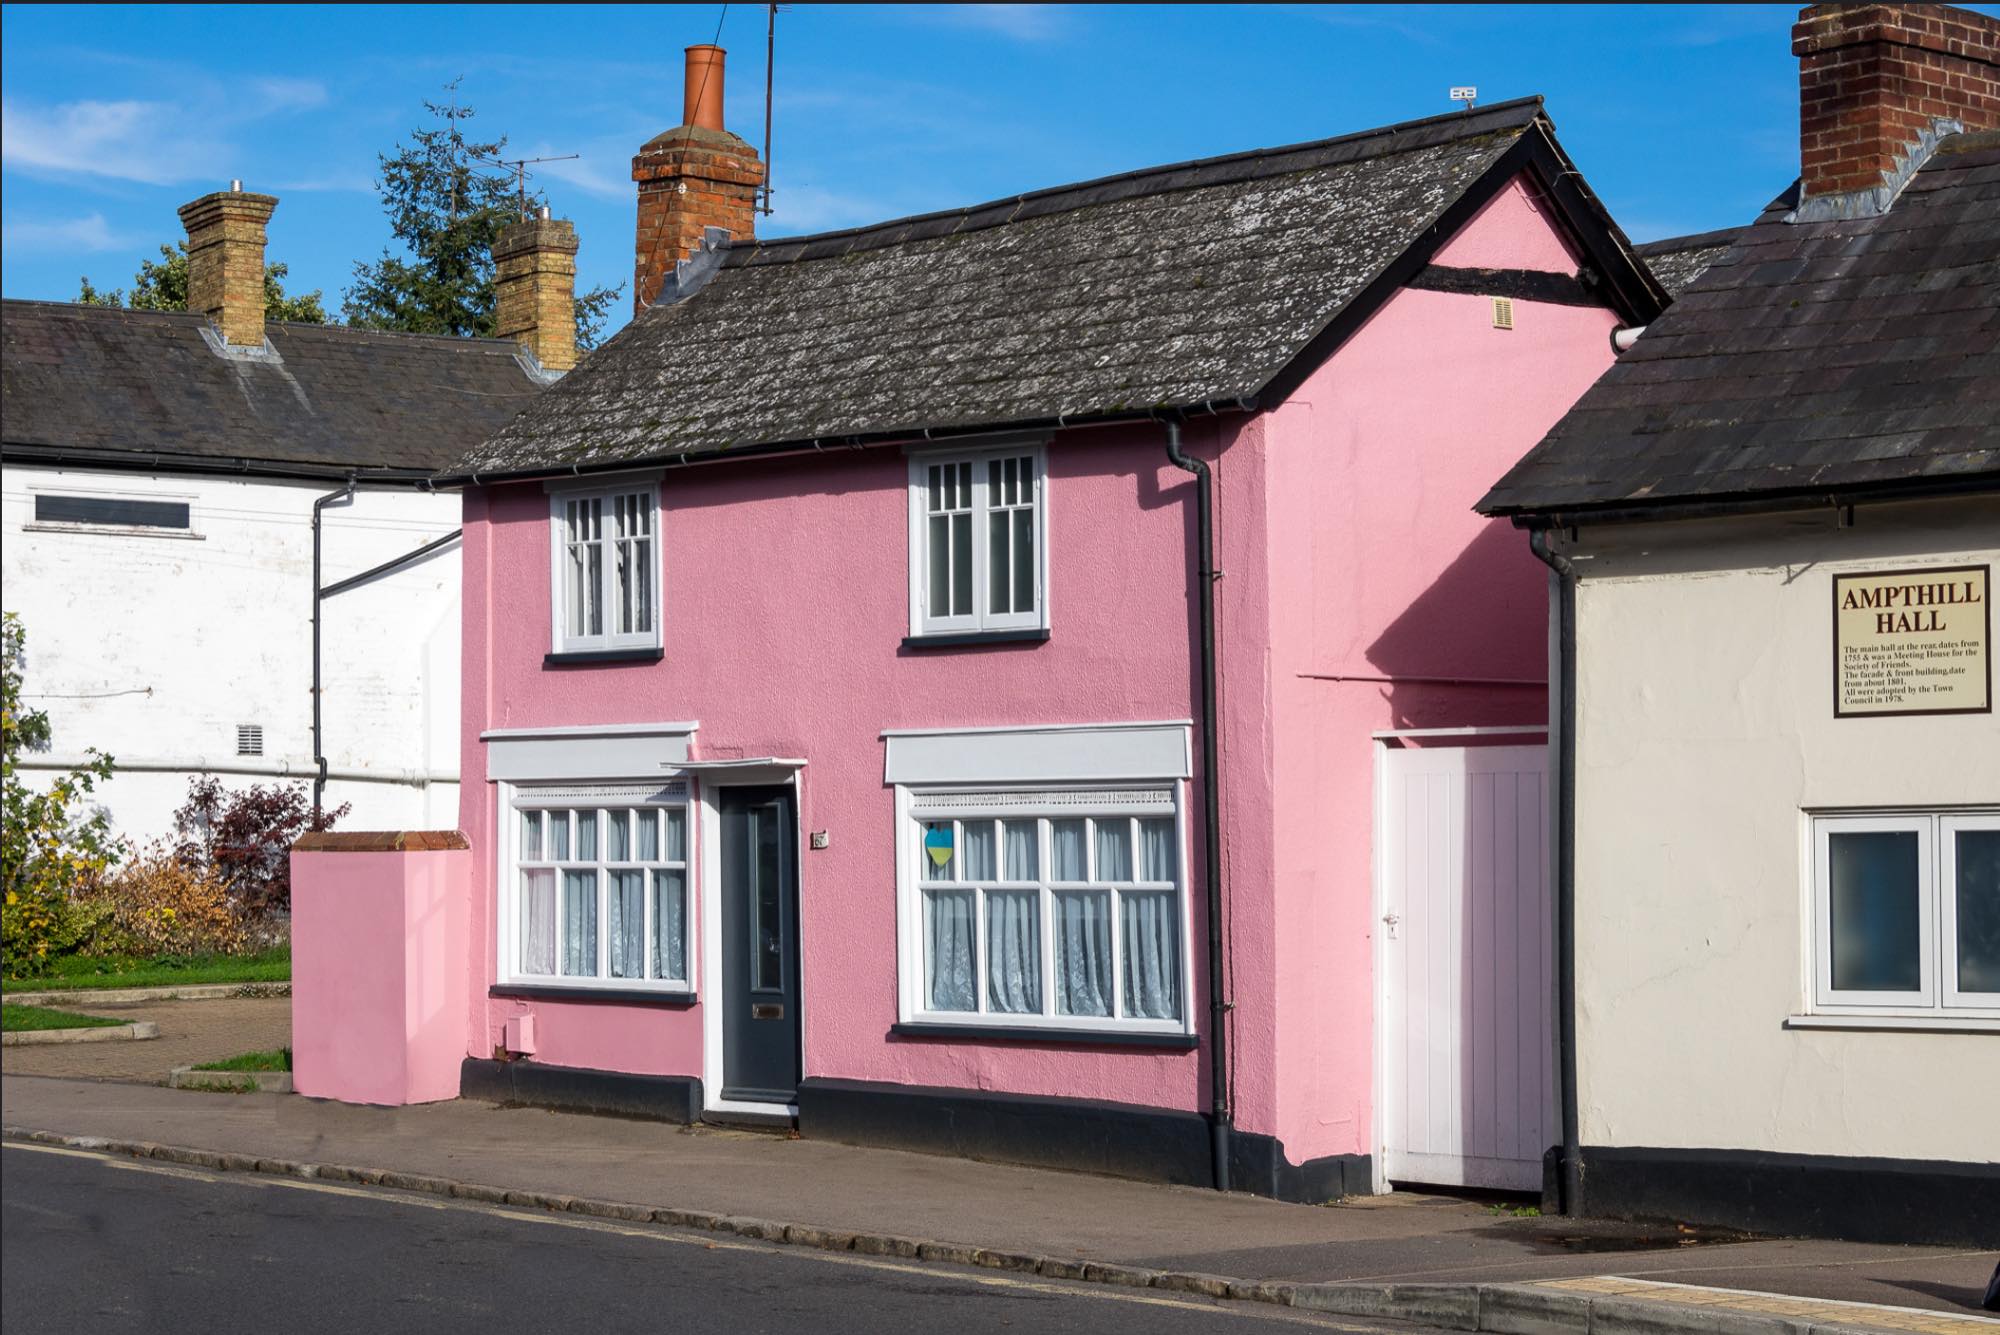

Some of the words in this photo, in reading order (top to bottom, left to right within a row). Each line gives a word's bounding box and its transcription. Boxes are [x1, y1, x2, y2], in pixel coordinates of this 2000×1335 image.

[1842, 582, 1981, 609] AMPTHILL
[1876, 610, 1946, 634] HALL
[1844, 662, 1869, 671] Society
[1877, 686, 1906, 696] adopted
[1908, 686, 1916, 695] by
[1933, 684, 1953, 692] Town
